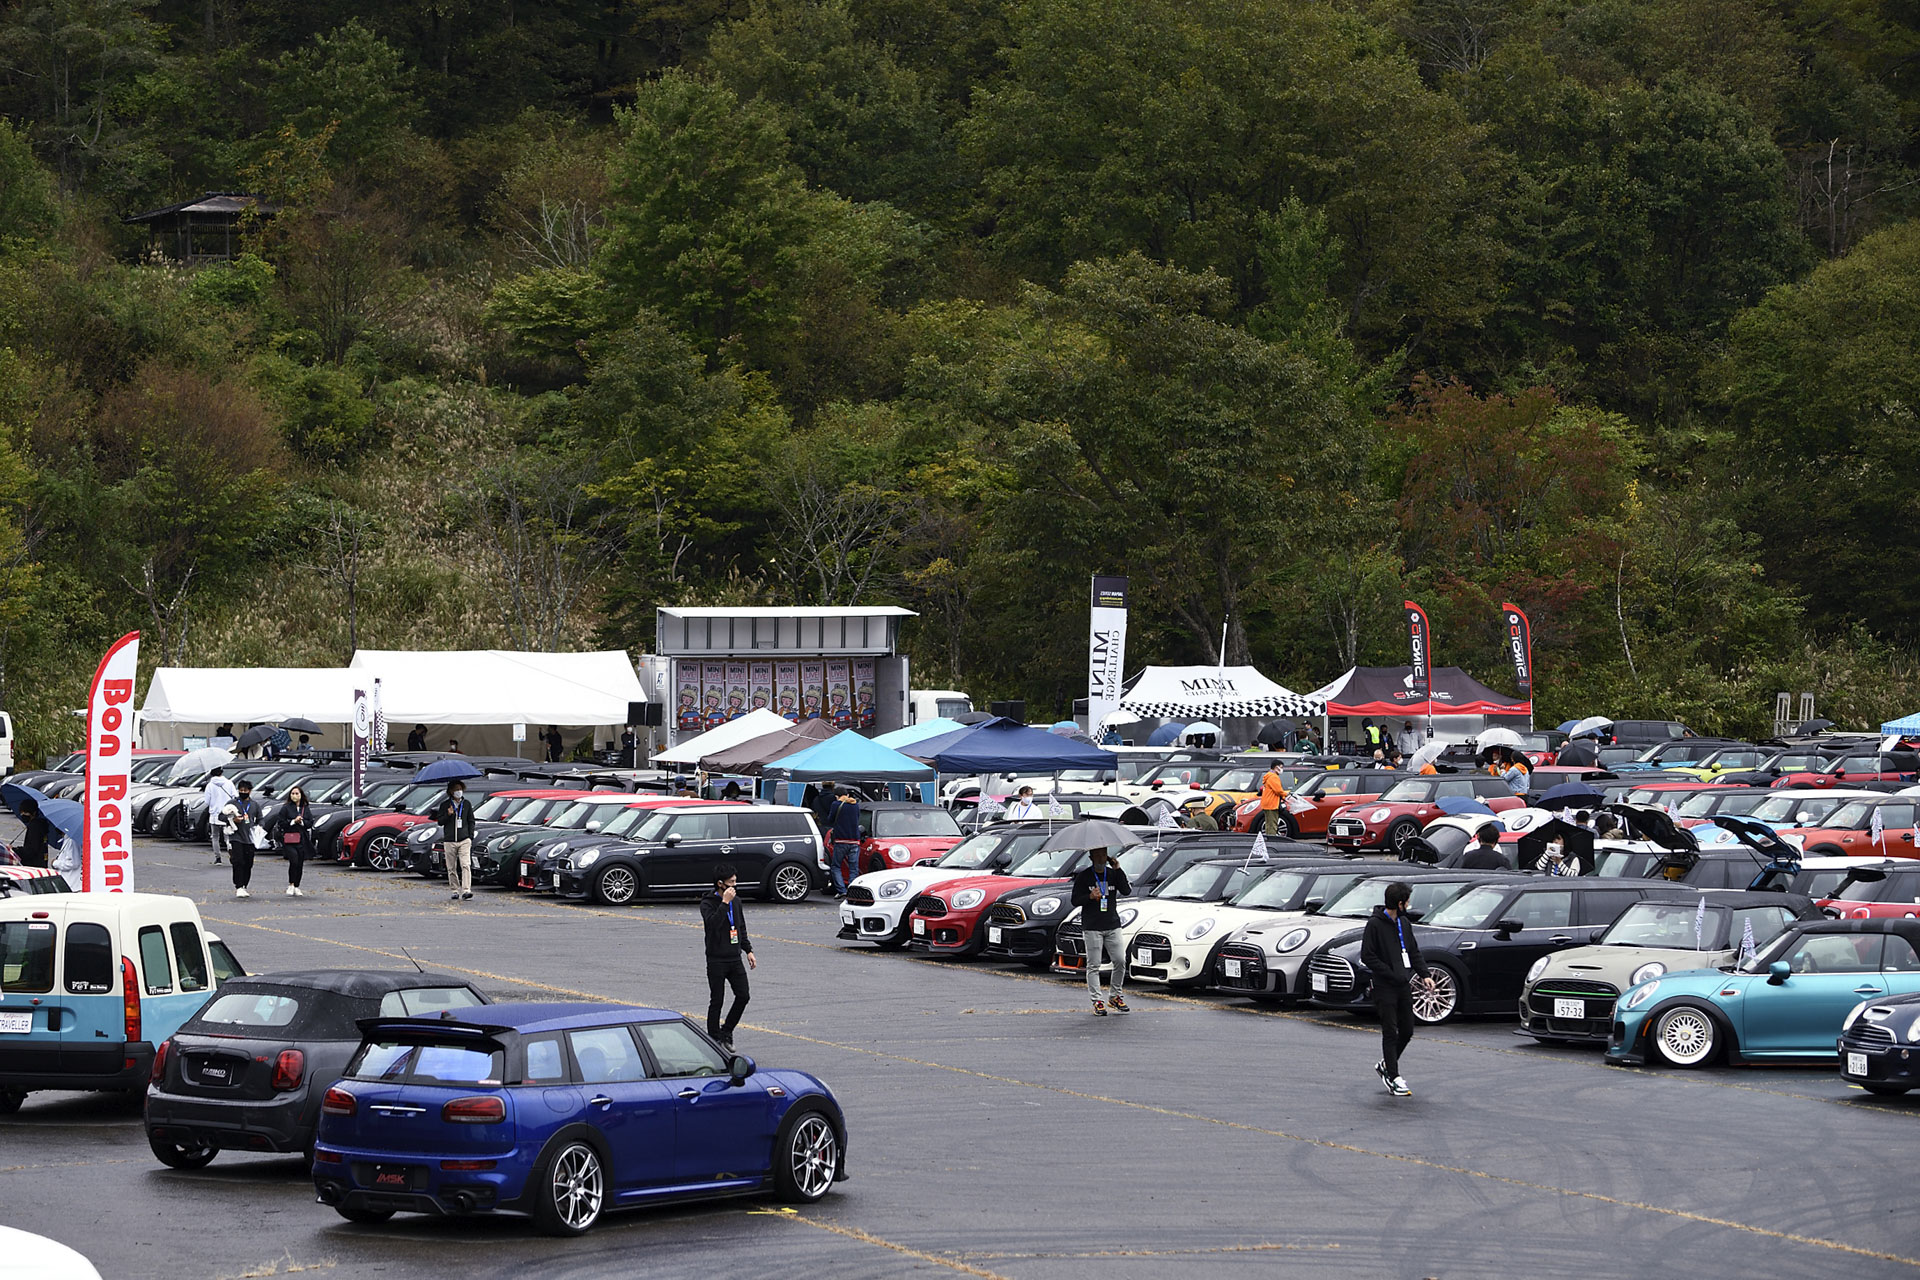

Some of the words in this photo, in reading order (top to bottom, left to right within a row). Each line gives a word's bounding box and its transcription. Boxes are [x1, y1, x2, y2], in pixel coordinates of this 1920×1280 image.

[99, 678, 132, 757] Bon
[1179, 678, 1238, 691] MINI
[98, 774, 129, 893] Racin
